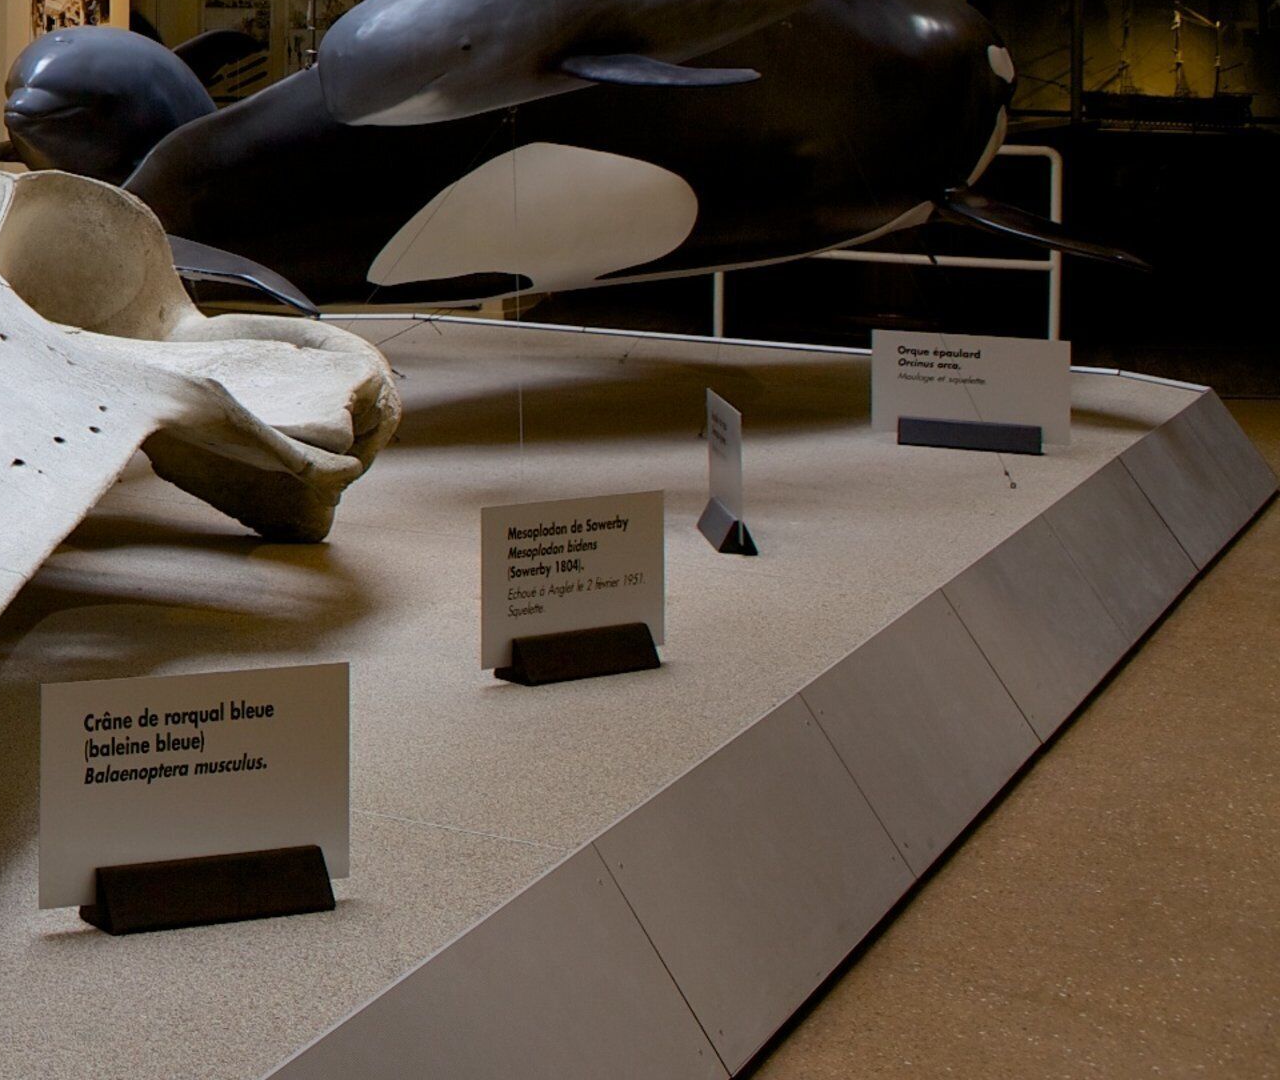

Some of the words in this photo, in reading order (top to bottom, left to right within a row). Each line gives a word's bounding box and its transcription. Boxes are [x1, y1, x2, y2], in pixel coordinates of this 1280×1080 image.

[897, 345, 929, 358] Orque
[932, 346, 982, 360] épaulard
[897, 357, 934, 369] Orcinus
[507, 522, 568, 542] Mesoplodon
[570, 519, 583, 534] de
[585, 514, 629, 533] Sowerby
[507, 542, 565, 561] Mesoplodon
[567, 538, 598, 554] bidens
[507, 562, 552, 581] (Sowerby
[586, 577, 593, 591] 2
[83, 711, 133, 732] Crâne
[137, 707, 159, 728] de
[163, 701, 225, 728] rorqual
[230, 699, 275, 721] bleue
[83, 735, 151, 763] (baleine
[155, 730, 206, 753] bleue)
[83, 761, 189, 785] Balaenoptera
[193, 752, 268, 776] musculus.
